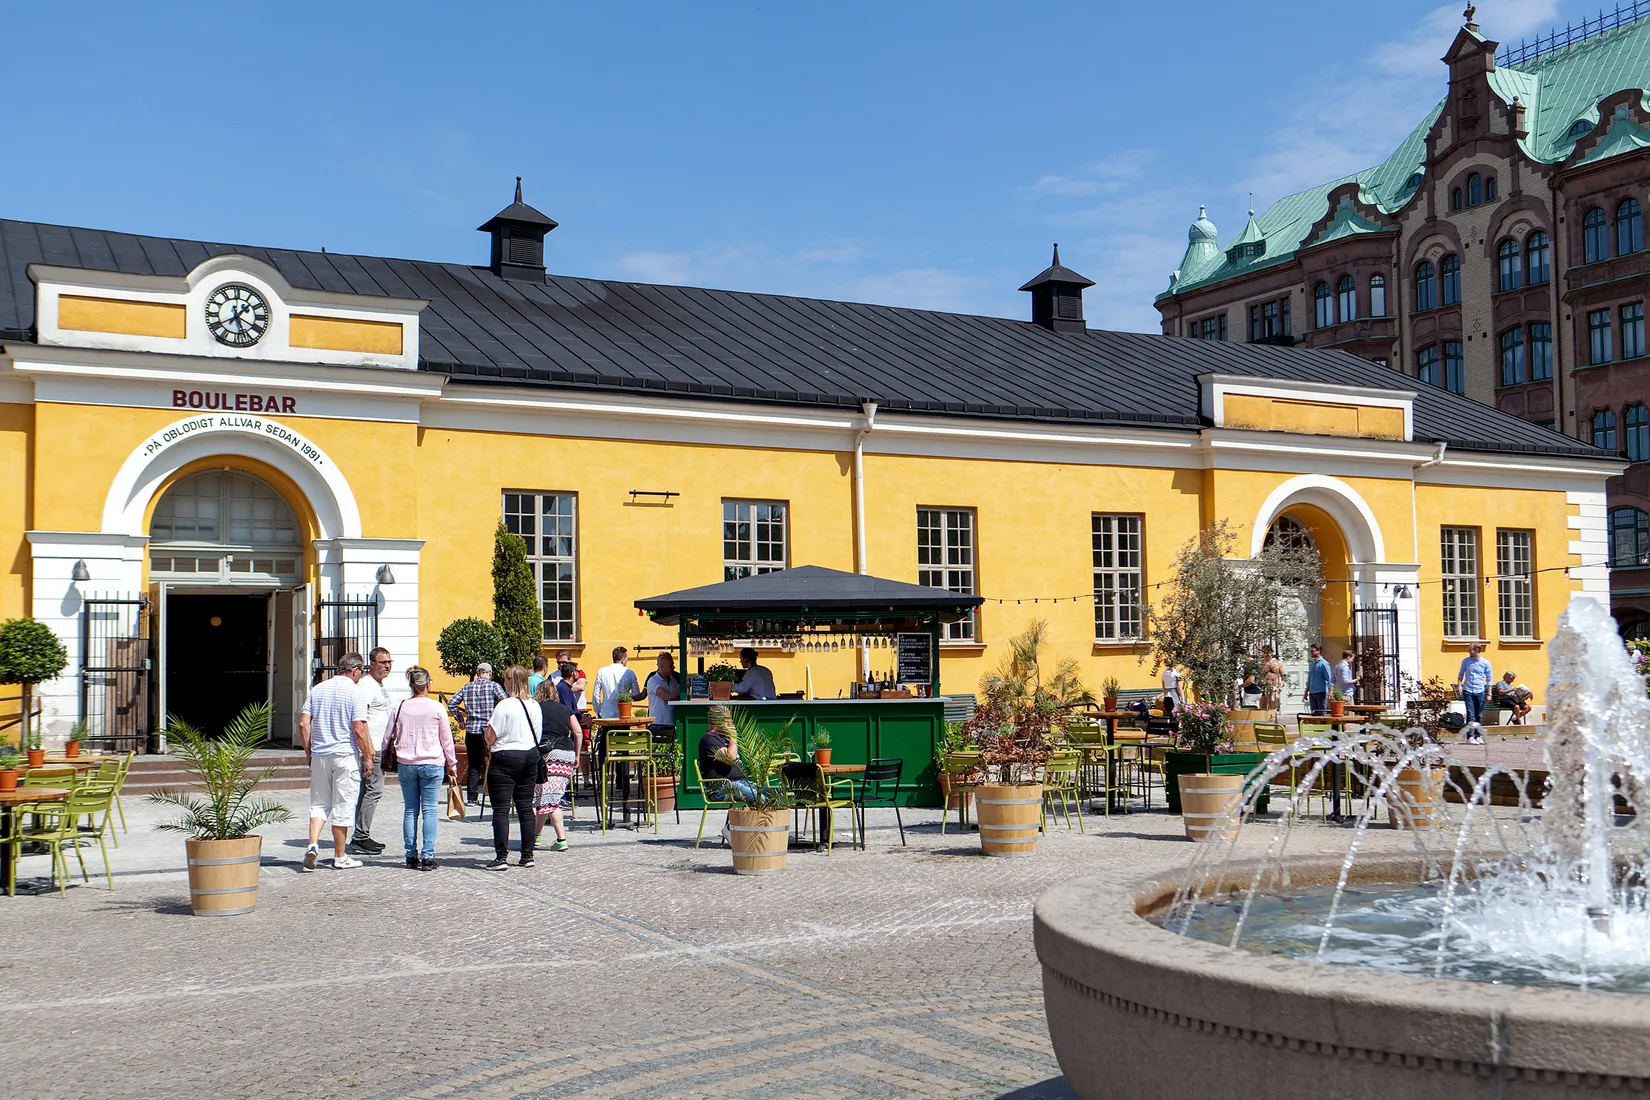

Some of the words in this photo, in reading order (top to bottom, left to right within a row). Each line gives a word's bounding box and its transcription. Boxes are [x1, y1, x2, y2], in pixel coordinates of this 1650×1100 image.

[173, 390, 297, 414] BOULEBAR
[146, 438, 163, 454] PÅ
[162, 417, 214, 443] OBLODIGT
[219, 417, 262, 431] ALLVAR
[265, 424, 301, 447] SEDAN
[301, 442, 321, 462] 1991
